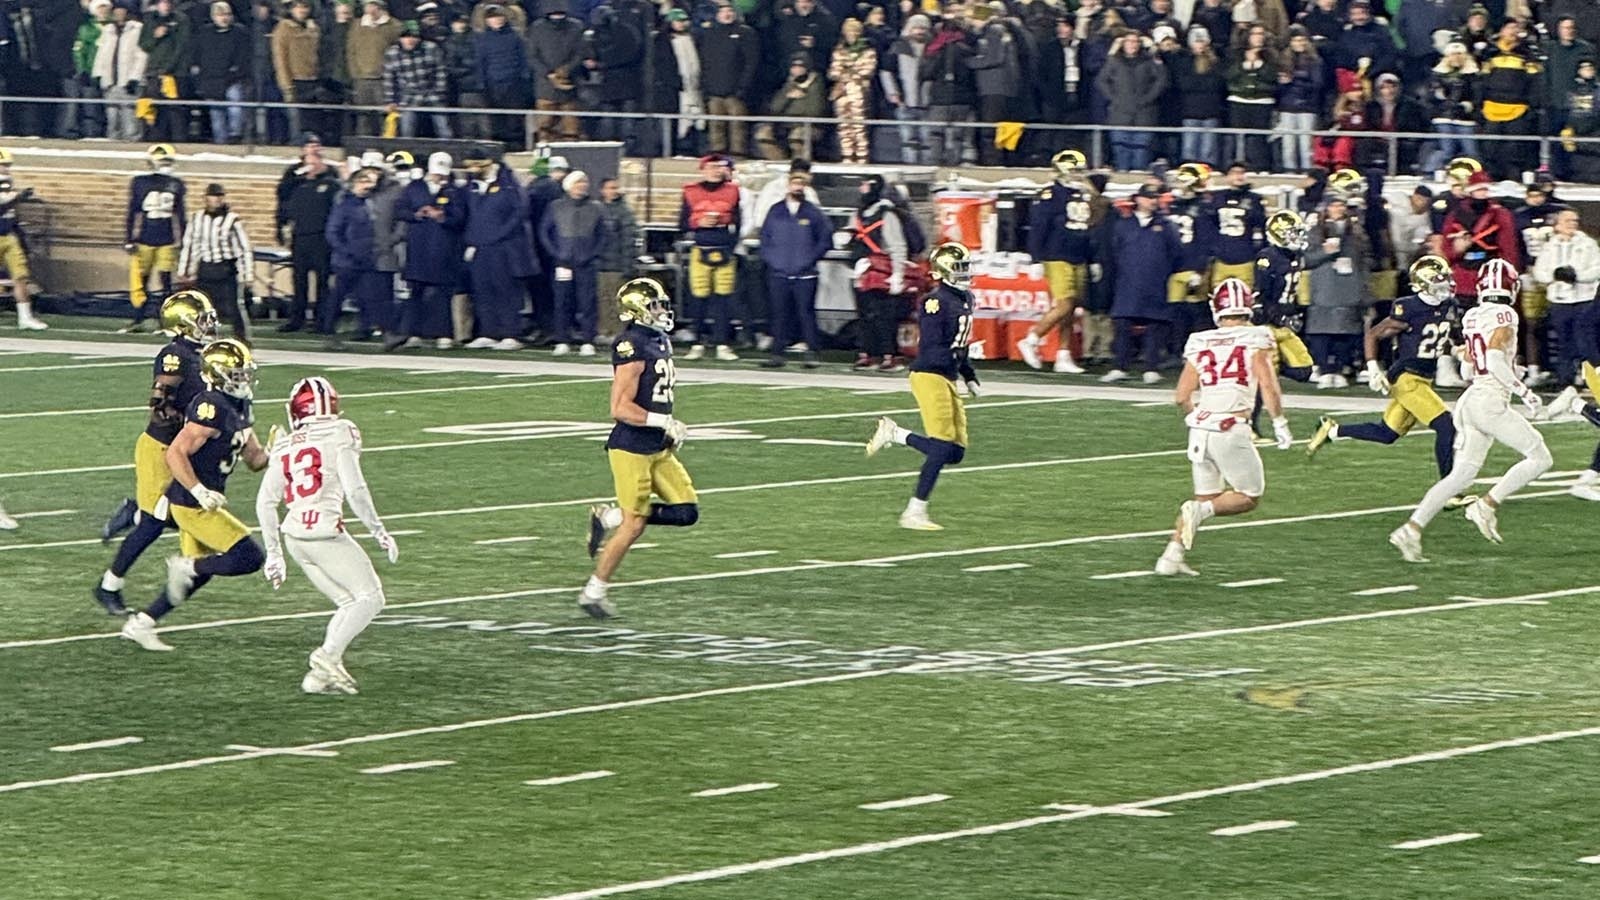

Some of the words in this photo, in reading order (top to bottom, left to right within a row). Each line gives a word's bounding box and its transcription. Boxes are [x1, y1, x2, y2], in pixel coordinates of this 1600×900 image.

[1496, 311, 1513, 324] 80
[1196, 345, 1249, 386] 34
[281, 446, 323, 505] 13
[369, 614, 823, 649] ROUND
[821, 645, 1265, 678] FIRST
